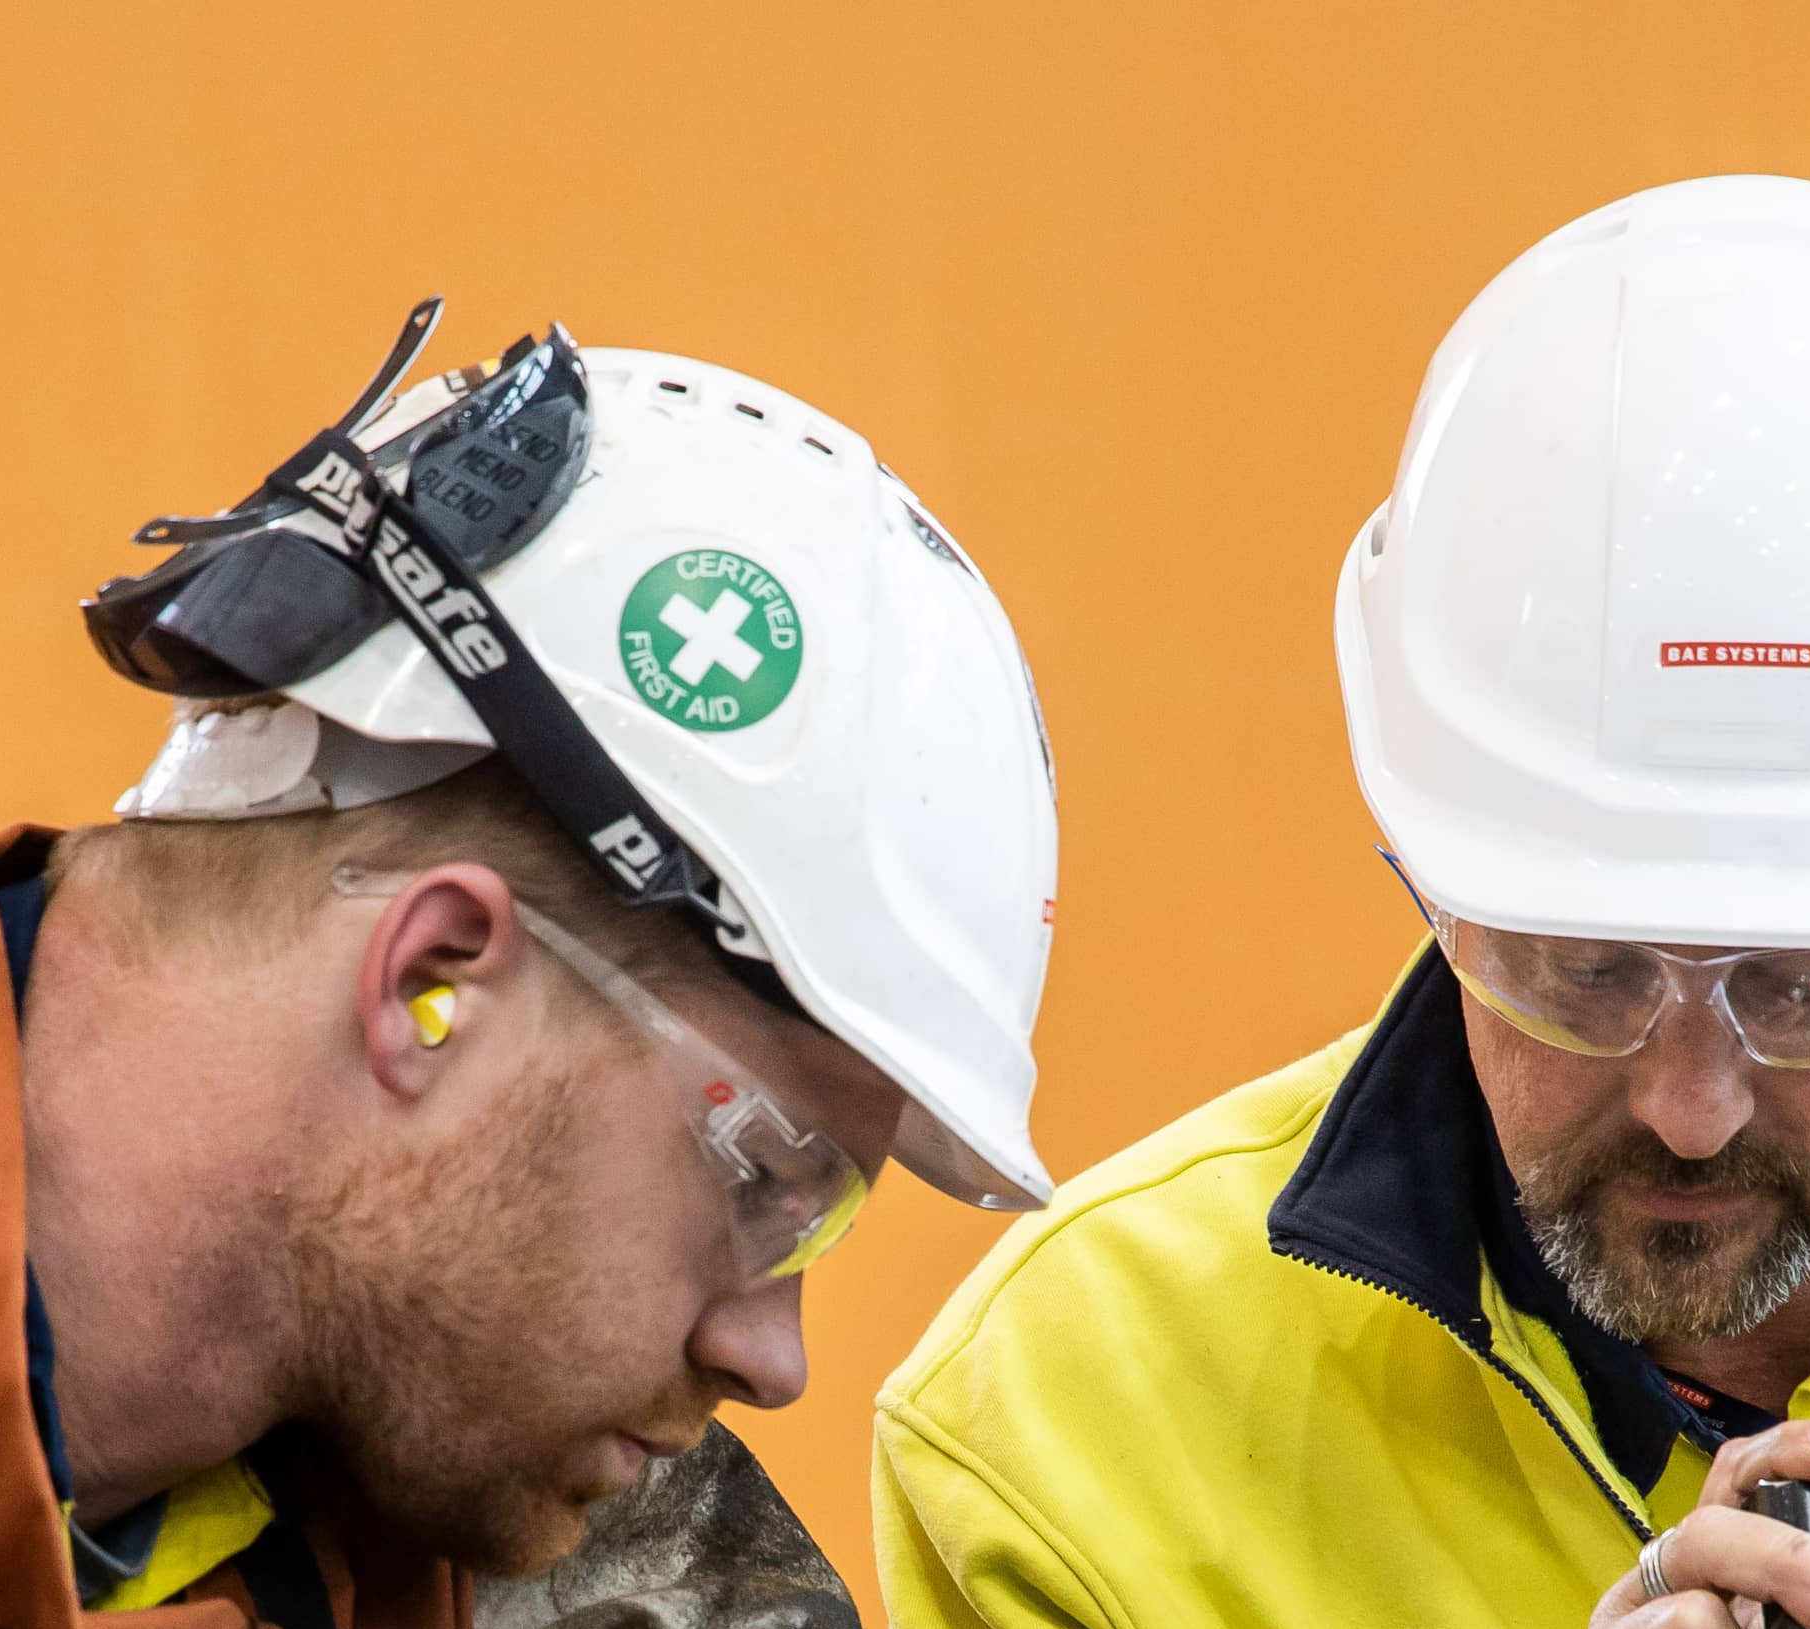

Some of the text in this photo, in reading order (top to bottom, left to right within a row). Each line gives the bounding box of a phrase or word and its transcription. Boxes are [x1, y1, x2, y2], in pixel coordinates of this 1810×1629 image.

[676, 553, 798, 650] CERTIFIED
[624, 630, 740, 723] FIRST AID
[1667, 646, 1709, 662] BAE
